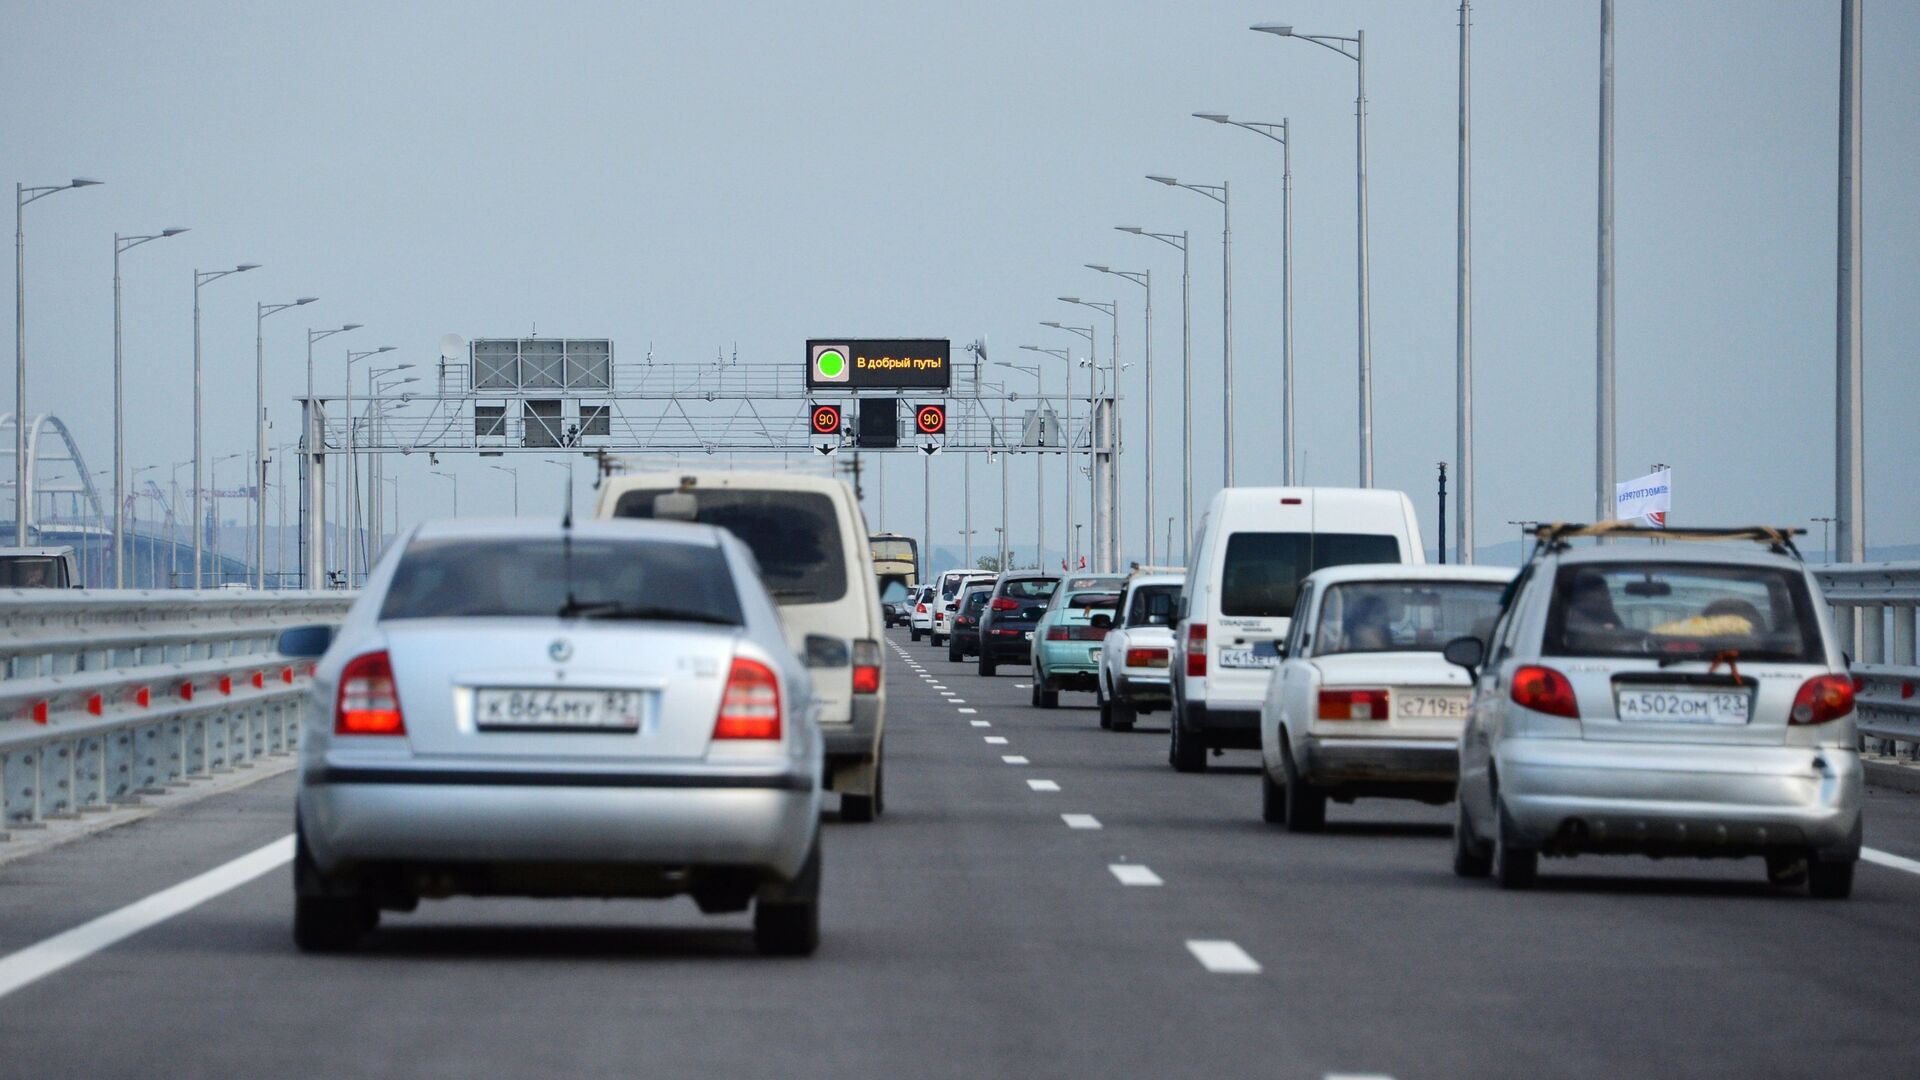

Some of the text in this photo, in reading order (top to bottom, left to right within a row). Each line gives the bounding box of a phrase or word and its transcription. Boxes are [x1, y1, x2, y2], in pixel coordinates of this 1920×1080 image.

[857, 357, 941, 370] В добрый путь!
[819, 414, 833, 425] 90
[923, 414, 938, 425] 90
[1627, 694, 1742, 716] А502ОМ 123
